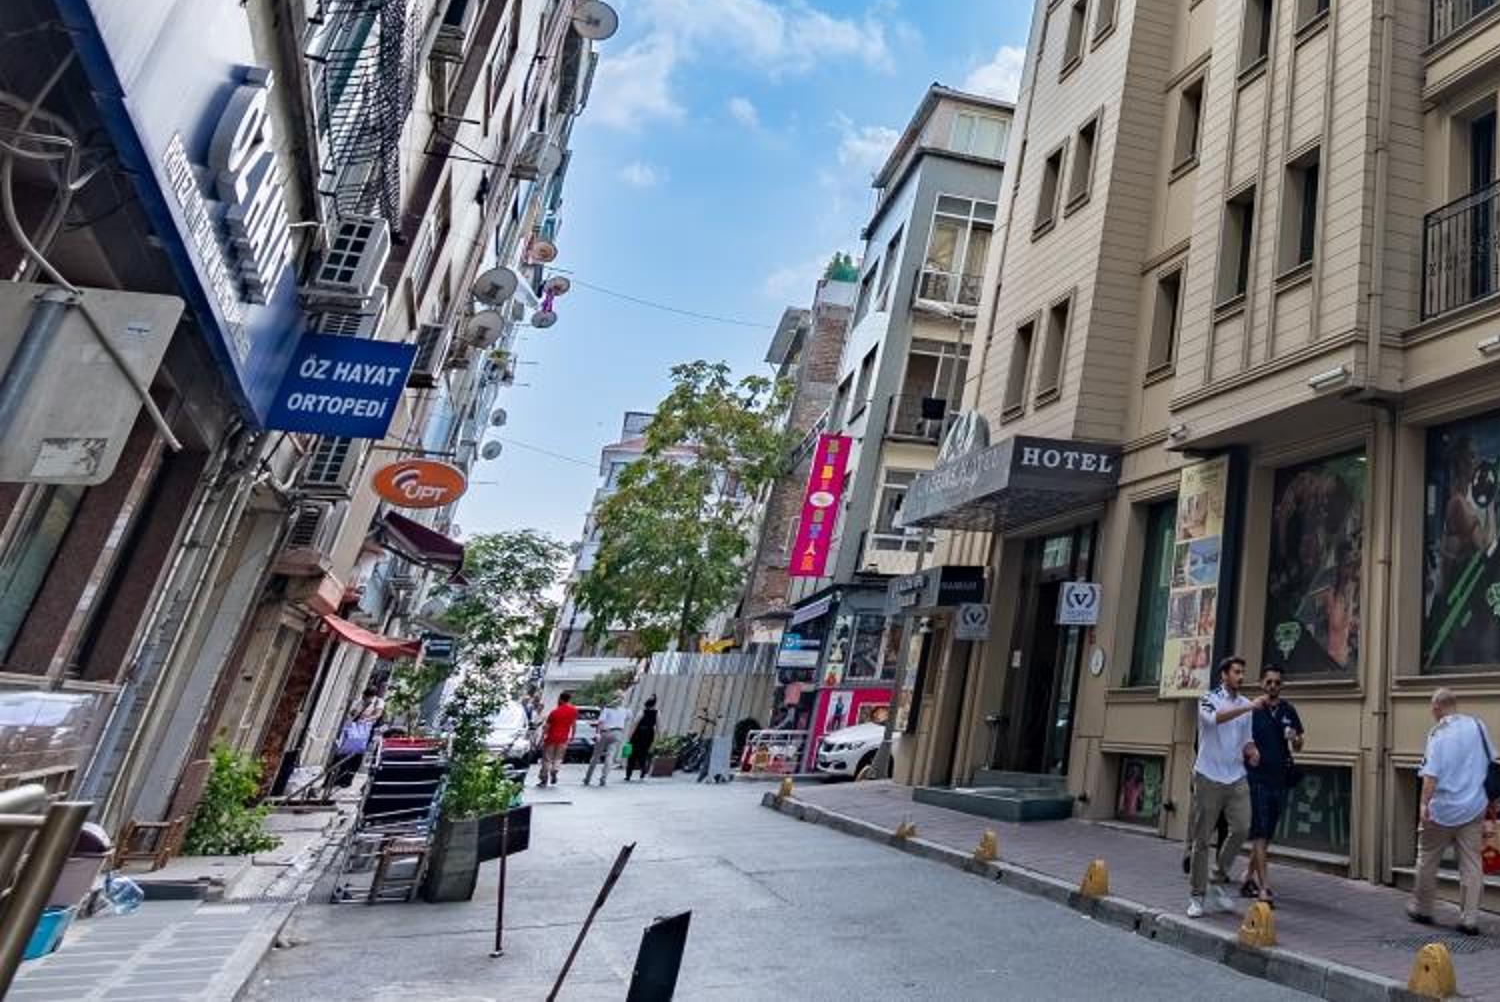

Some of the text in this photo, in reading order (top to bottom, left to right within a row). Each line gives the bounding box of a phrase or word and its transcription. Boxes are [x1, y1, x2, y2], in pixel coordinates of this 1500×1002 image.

[243, 152, 294, 307] HAYAT
[300, 353, 400, 386] ÖZ HAYAT
[287, 393, 389, 418] ORTOPEDİ
[1021, 447, 1113, 473] HOTEL
[404, 483, 448, 501] UPT
